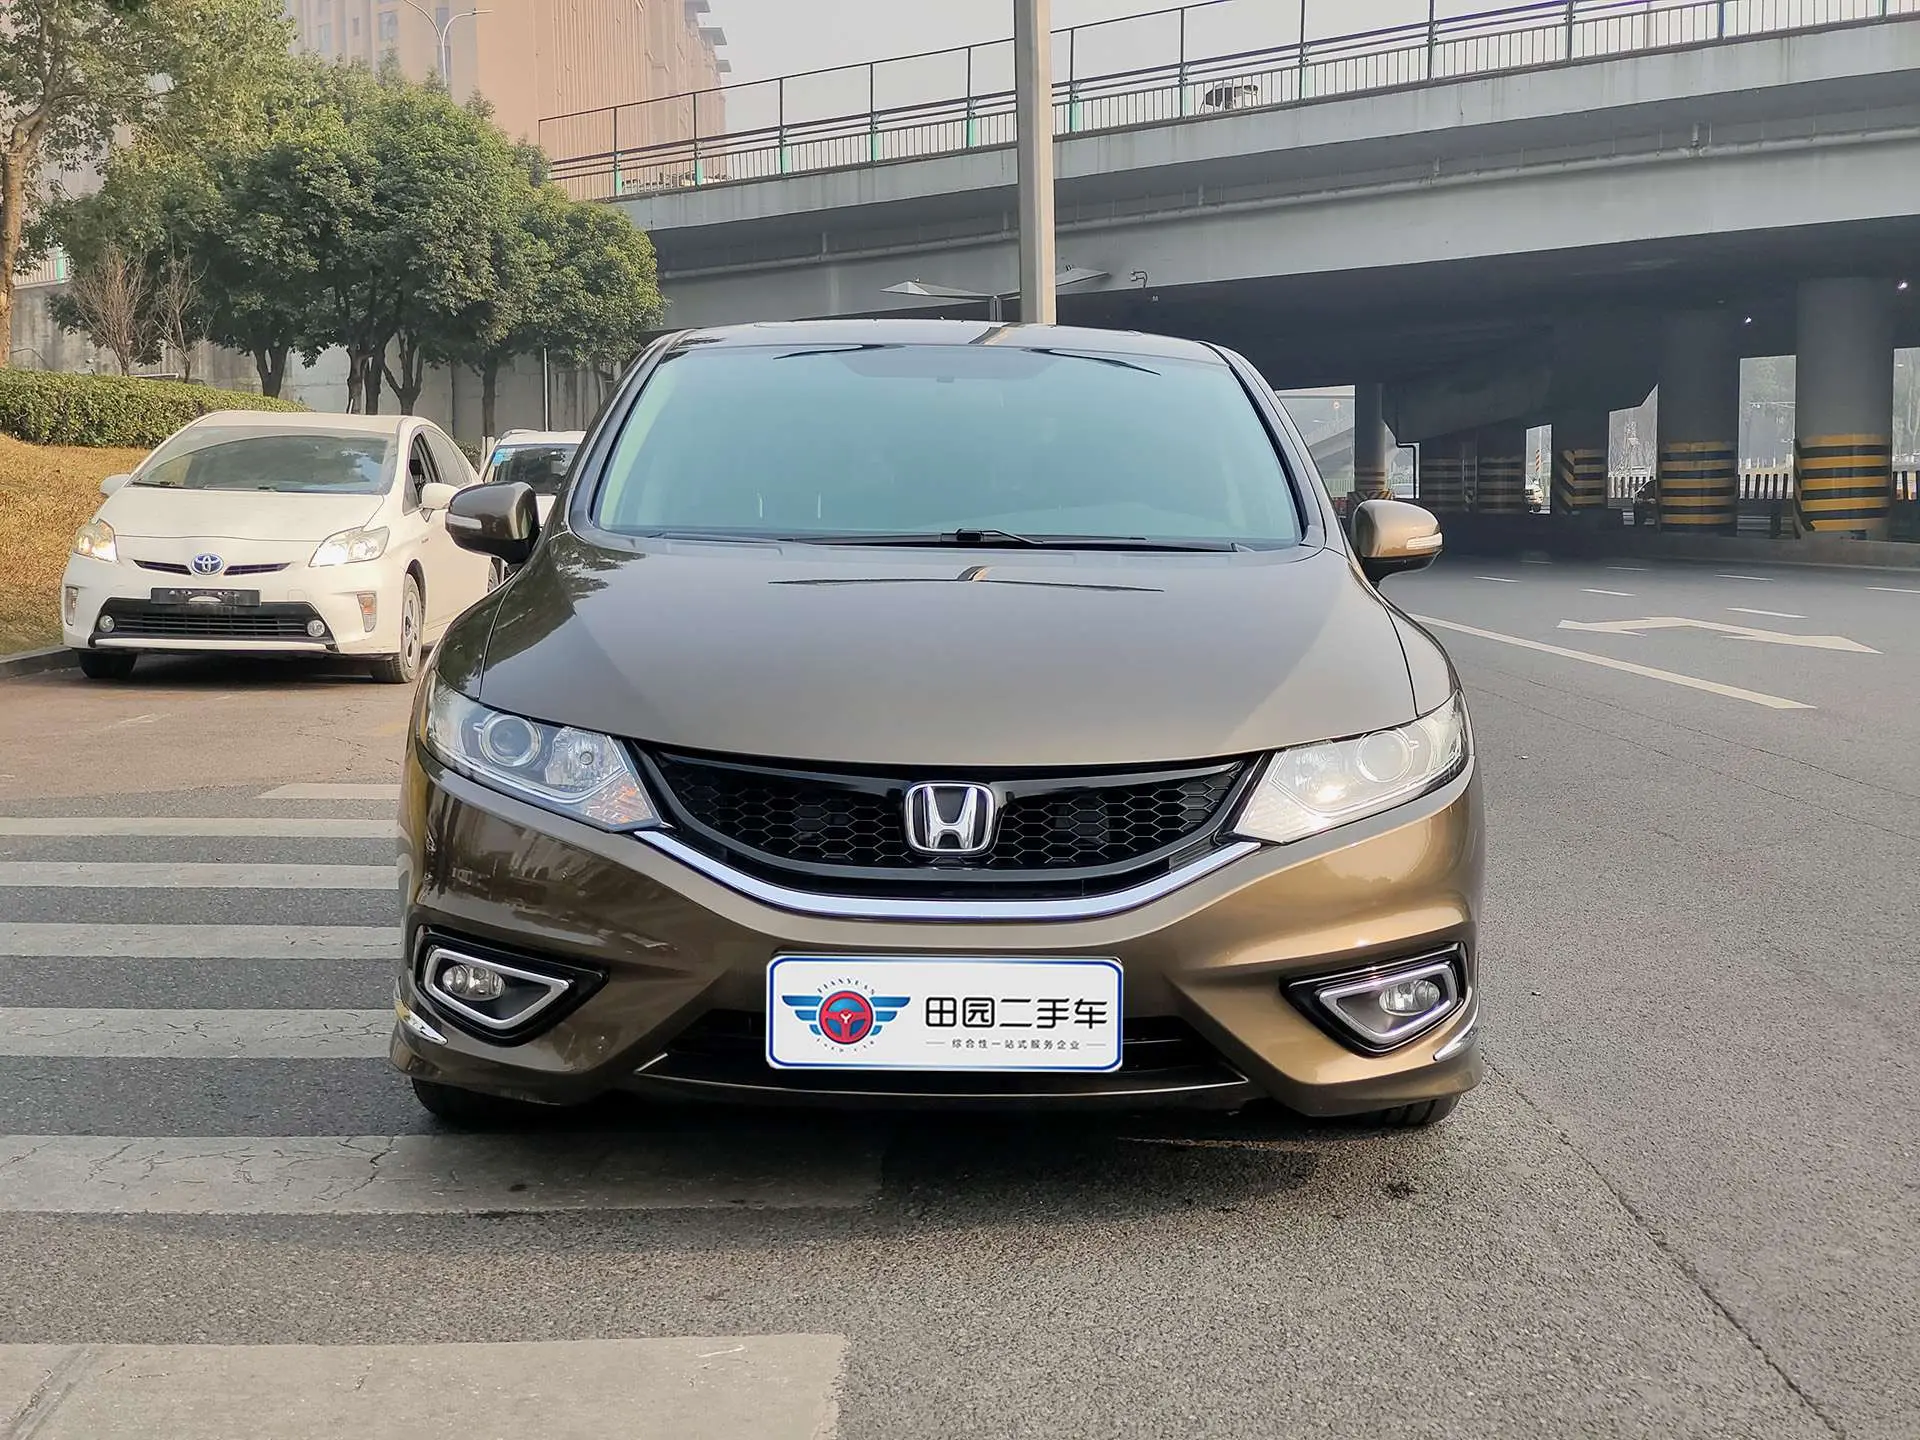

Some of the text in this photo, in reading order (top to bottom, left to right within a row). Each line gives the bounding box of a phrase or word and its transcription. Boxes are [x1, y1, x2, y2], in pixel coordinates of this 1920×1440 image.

[840, 1013, 852, 1024] Y
[926, 997, 1107, 1029] 田园二手车
[952, 1038, 1080, 1050] 综合性一站式服务企业
